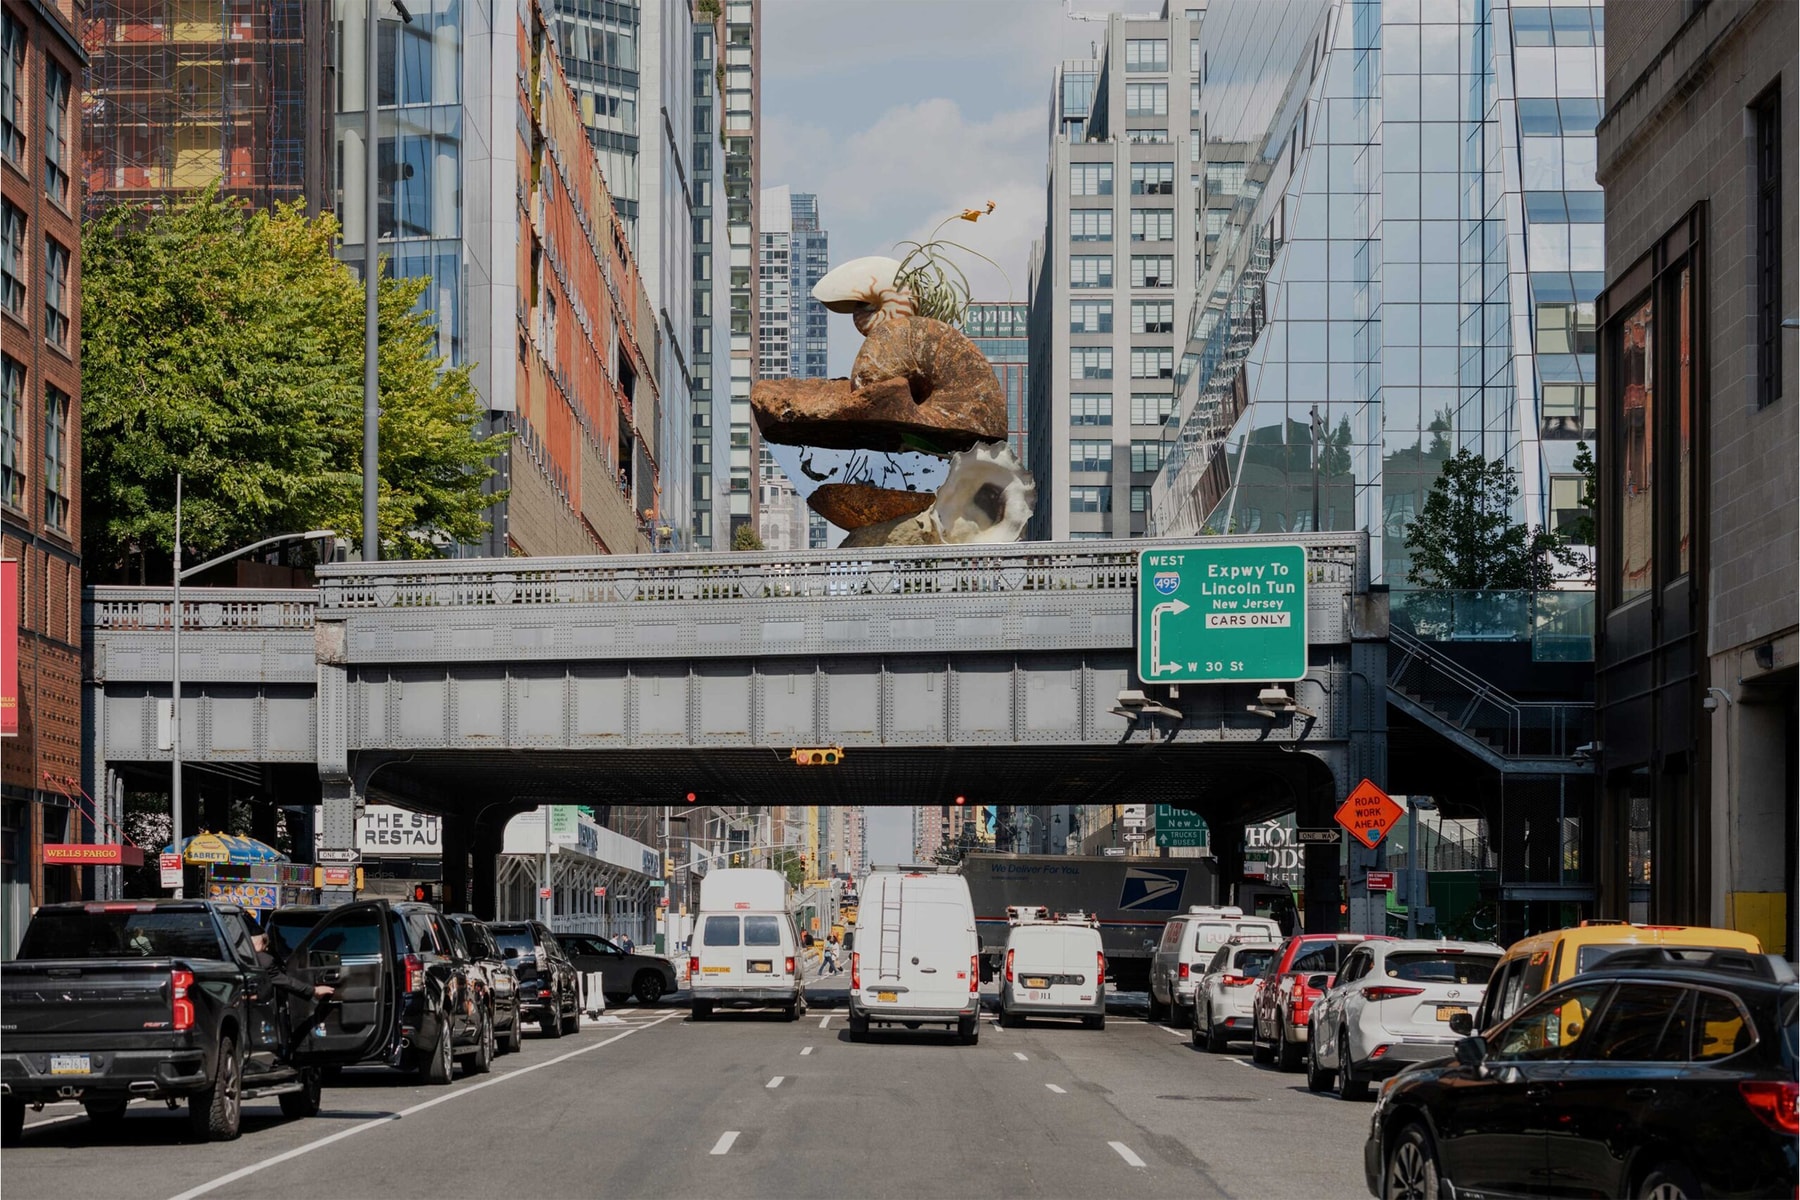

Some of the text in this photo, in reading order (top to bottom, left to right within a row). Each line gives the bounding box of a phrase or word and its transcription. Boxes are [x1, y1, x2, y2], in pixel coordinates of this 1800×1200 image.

[1150, 555, 1185, 566] WEST
[1208, 563, 1289, 580] Expwy To
[1155, 578, 1178, 589] 495
[1202, 581, 1296, 596] Lincoln Tun
[1213, 599, 1284, 610] New Jersey
[1211, 614, 1285, 626] CARS ONLY
[1188, 661, 1244, 672] W 30 St
[1354, 797, 1380, 806] ROAD
[1355, 808, 1381, 818] WORK
[364, 813, 403, 828] THE
[1168, 819, 1191, 827] New
[1354, 819, 1386, 829] AHEAD
[47, 849, 117, 858] WELLS FARGO
[187, 851, 227, 859] SABRETT
[991, 863, 1080, 874] We Deliver For You.
[364, 871, 396, 879] HOPS
